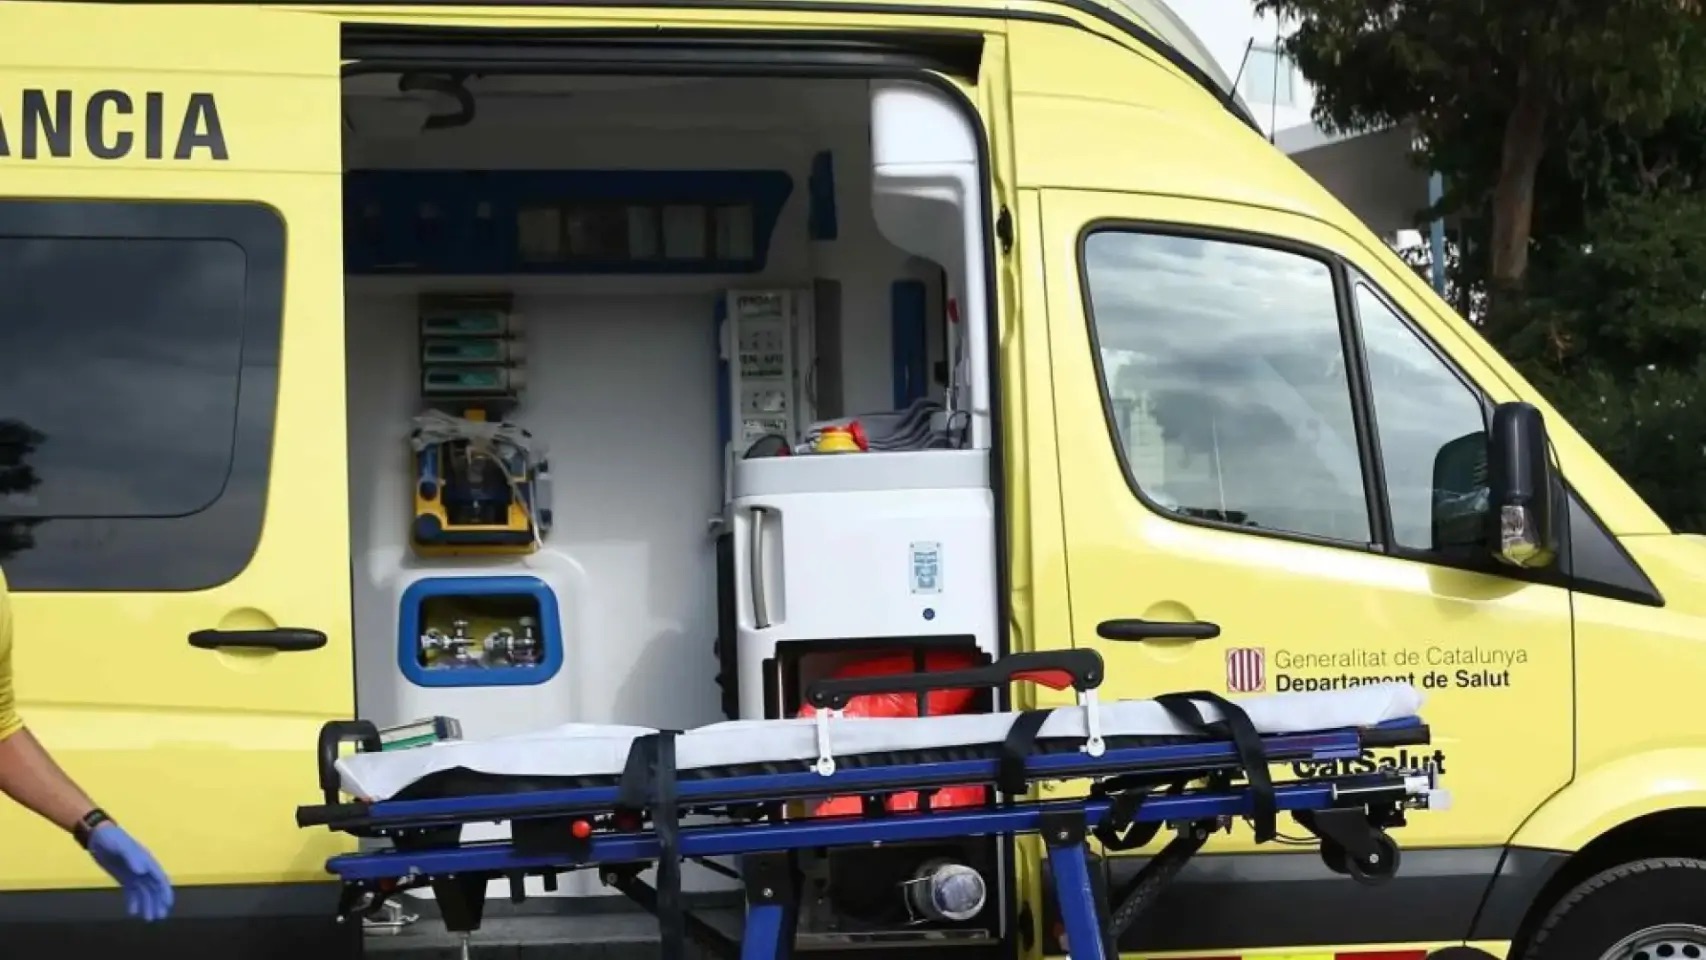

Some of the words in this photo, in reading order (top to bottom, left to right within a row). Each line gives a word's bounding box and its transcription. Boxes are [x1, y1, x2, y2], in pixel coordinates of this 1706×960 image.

[0, 89, 229, 160] NCIA
[1274, 648, 1387, 669] Generalitat
[1394, 648, 1420, 666] de
[1426, 646, 1528, 668] Catalunya
[1422, 671, 1448, 688] de
[1455, 669, 1510, 688] Salut
